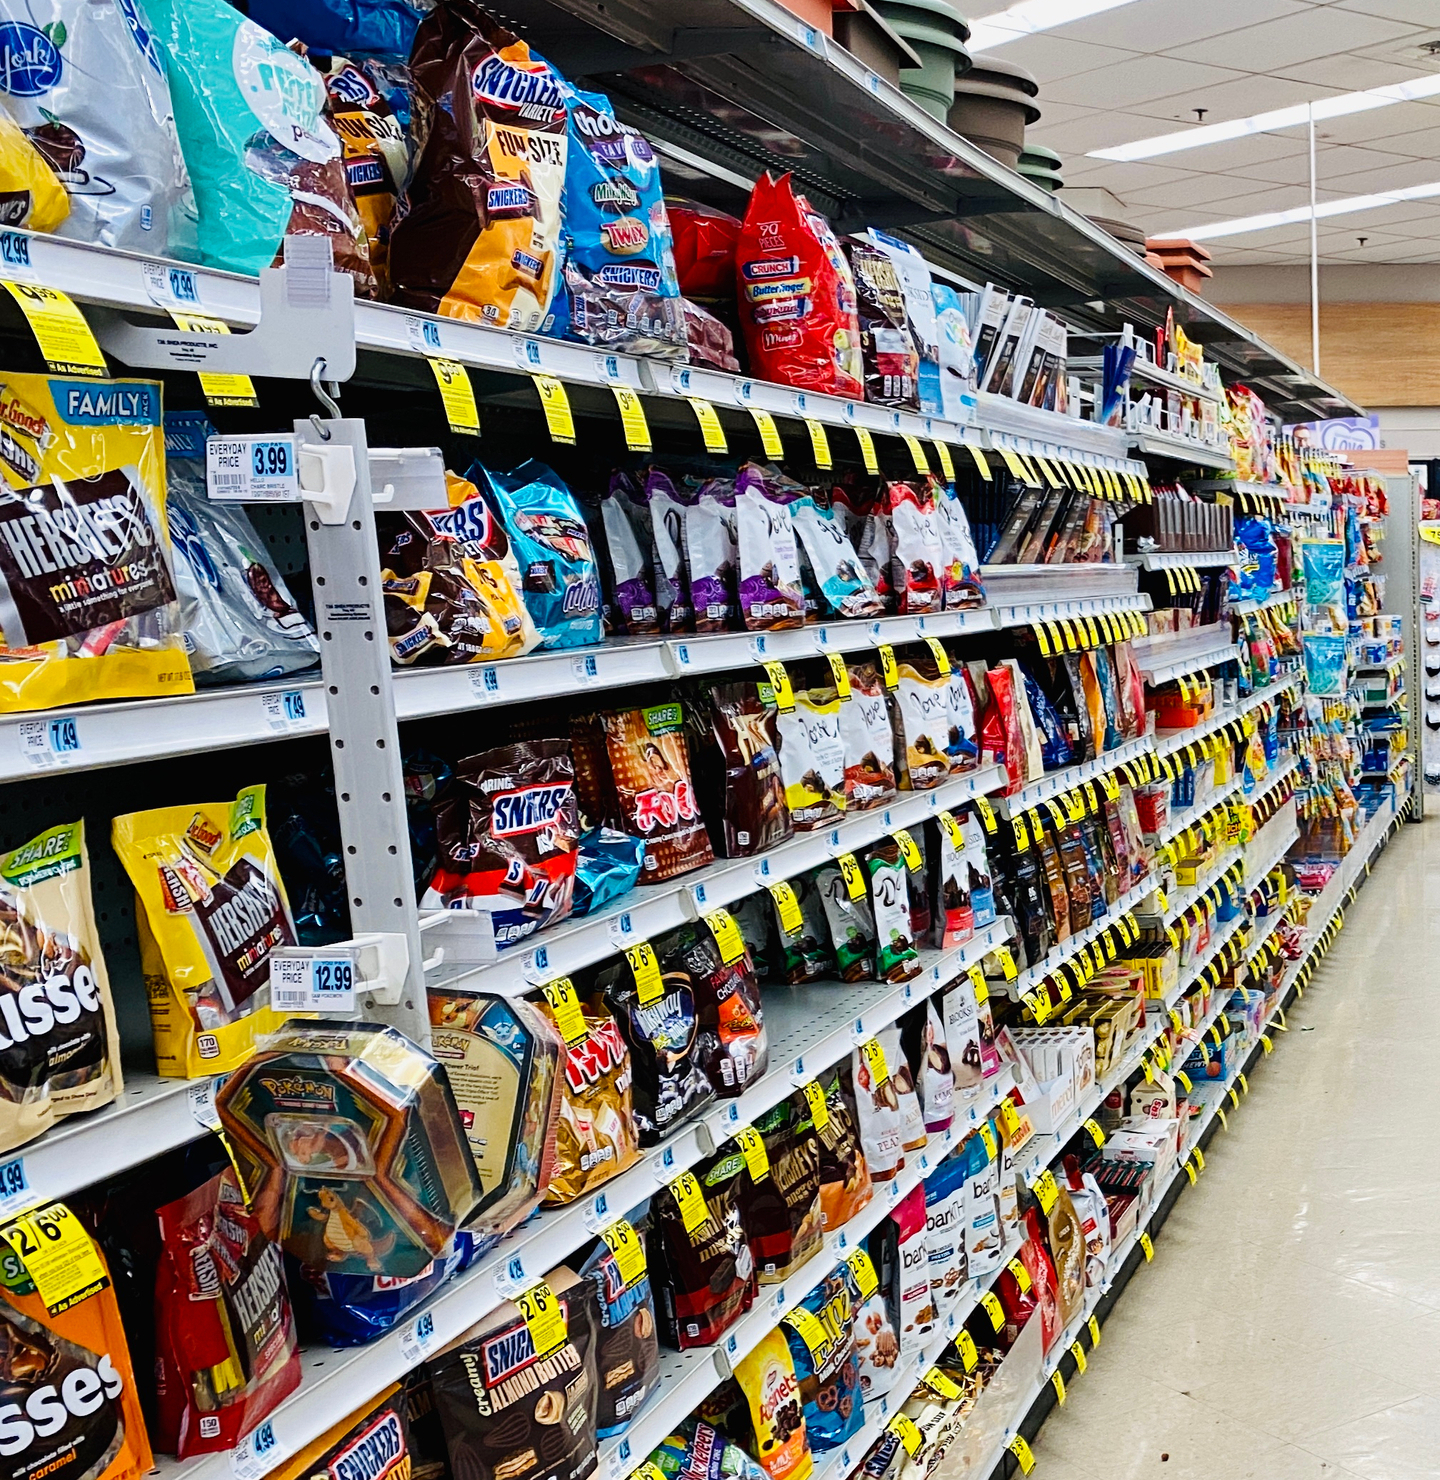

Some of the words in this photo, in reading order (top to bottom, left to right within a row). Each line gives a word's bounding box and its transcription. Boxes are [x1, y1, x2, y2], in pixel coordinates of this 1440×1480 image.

[474, 58, 565, 109] SNICKERS
[518, 101, 555, 123] VARIETY
[496, 130, 527, 158] FUN
[528, 137, 563, 167] SIZE
[488, 188, 530, 207] SNICKERS
[602, 222, 648, 248] TWIX
[760, 223, 777, 236] 90
[758, 237, 785, 248] PIECES
[513, 250, 541, 272] SNICKERS
[750, 262, 788, 277] CRUNCH
[602, 265, 660, 288] SNICKERS
[752, 281, 804, 297] Butterfinger
[68, 392, 139, 417] FAMILY
[210, 444, 247, 455] EVERYDAY
[219, 456, 239, 467] PRICE
[255, 447, 286, 475] 3.99
[50, 562, 148, 602] miniatures
[648, 710, 672, 725] SHARE
[11, 832, 67, 869] SHARE
[274, 961, 309, 971] EVERYDAY
[283, 973, 302, 983] PRICE
[315, 965, 352, 990] 12.99
[199, 1037, 215, 1047] 170
[706, 1158, 737, 1182] SHARE
[463, 1353, 492, 1417] creamy
[490, 1370, 538, 1413] ALMOND
[537, 1344, 581, 1388] BUTTER
[202, 1418, 217, 1429] 150
[29, 1448, 77, 1480] caramel
